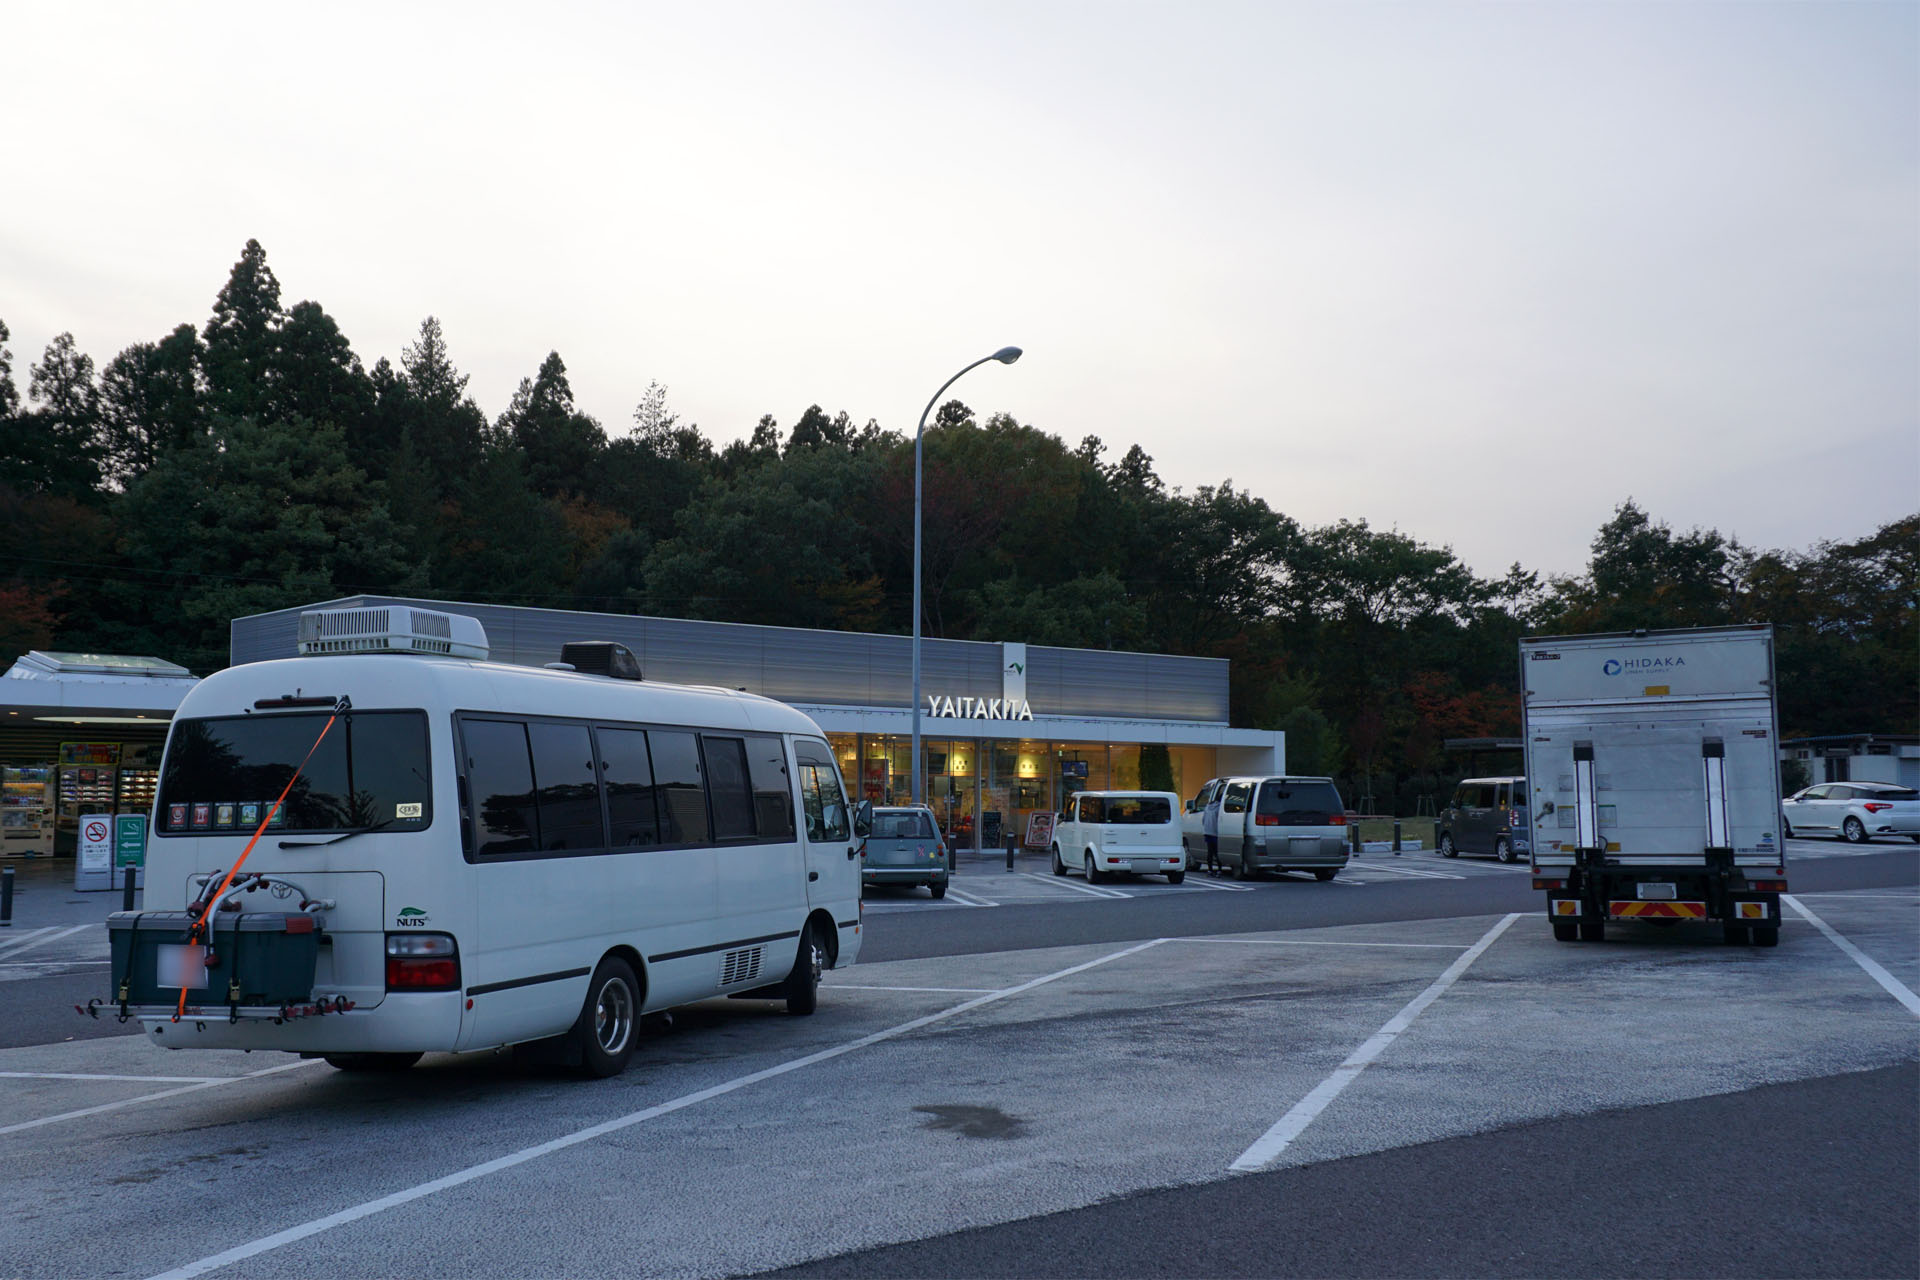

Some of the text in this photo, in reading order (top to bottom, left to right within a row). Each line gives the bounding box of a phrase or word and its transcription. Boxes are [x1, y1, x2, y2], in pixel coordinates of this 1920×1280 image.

[1624, 657, 1686, 668] HIDAKA
[928, 695, 1034, 721] YAITAKITA
[396, 918, 425, 927] NUTS
